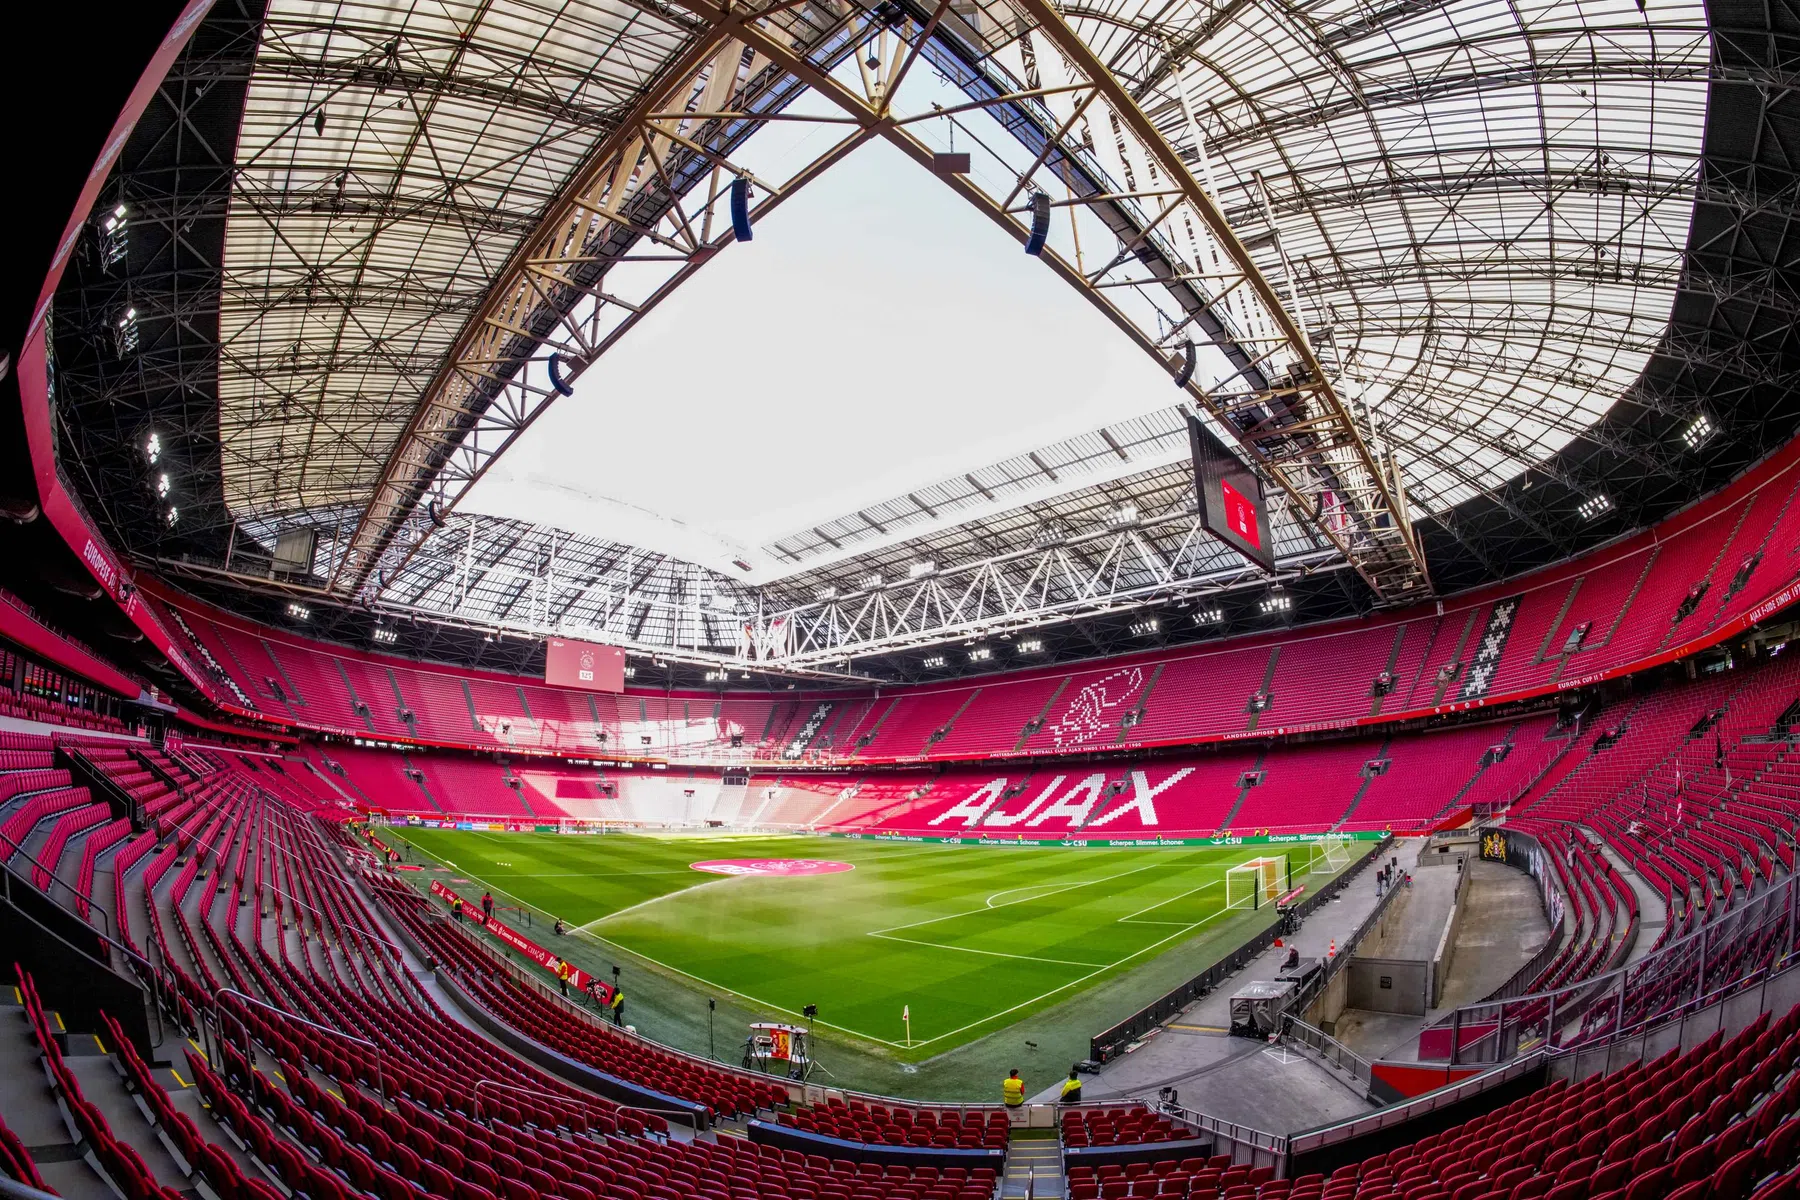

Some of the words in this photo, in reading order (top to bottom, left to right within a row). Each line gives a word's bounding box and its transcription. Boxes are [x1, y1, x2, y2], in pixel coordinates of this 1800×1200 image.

[83, 539, 111, 582] EUROPESE
[1750, 609, 1762, 622] AJAX
[1558, 680, 1581, 689] EUROPA
[928, 767, 1195, 826] AJAX
[1225, 837, 1242, 845] CSU
